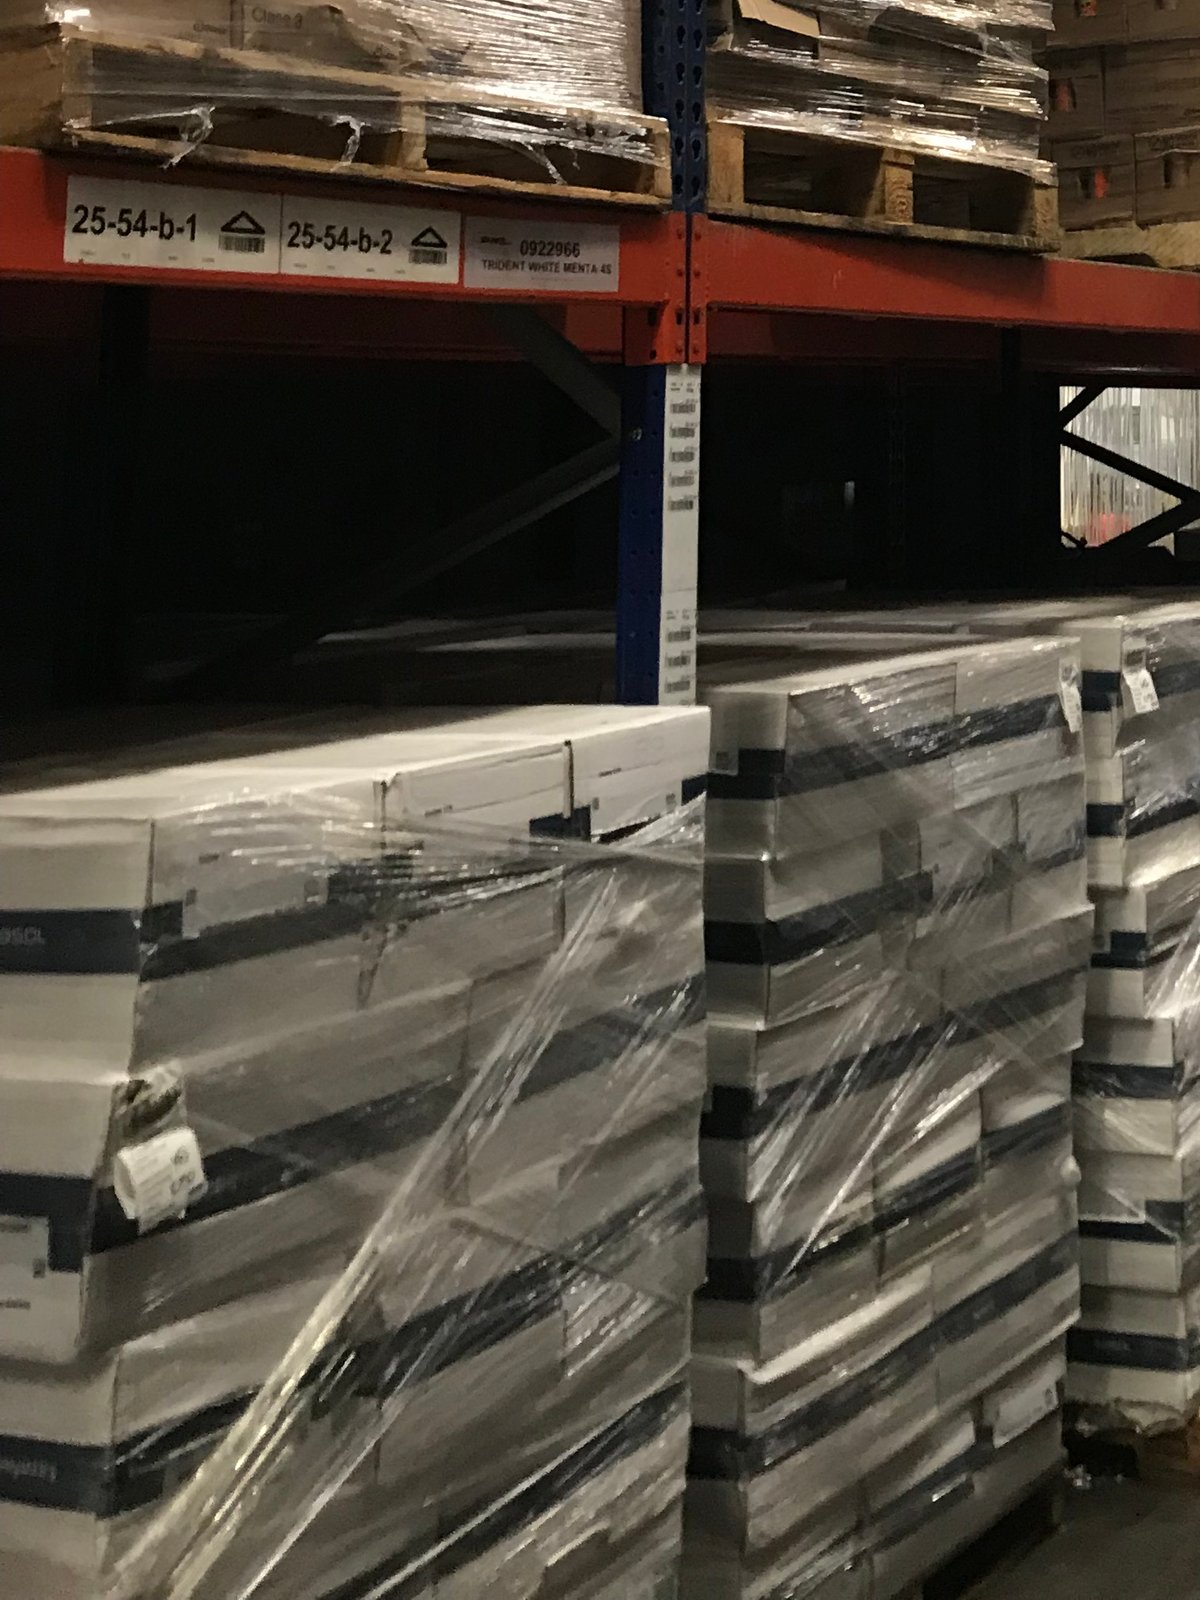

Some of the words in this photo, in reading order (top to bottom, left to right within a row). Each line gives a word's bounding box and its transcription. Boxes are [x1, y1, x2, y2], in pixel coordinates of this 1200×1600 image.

[72, 204, 198, 243] 25-54-b-1
[286, 220, 393, 256] 25-54-b-2
[519, 238, 581, 258] 0922966
[482, 258, 526, 272] TRIDENT
[528, 261, 561, 274] WHITE
[563, 262, 598, 274] MENTA
